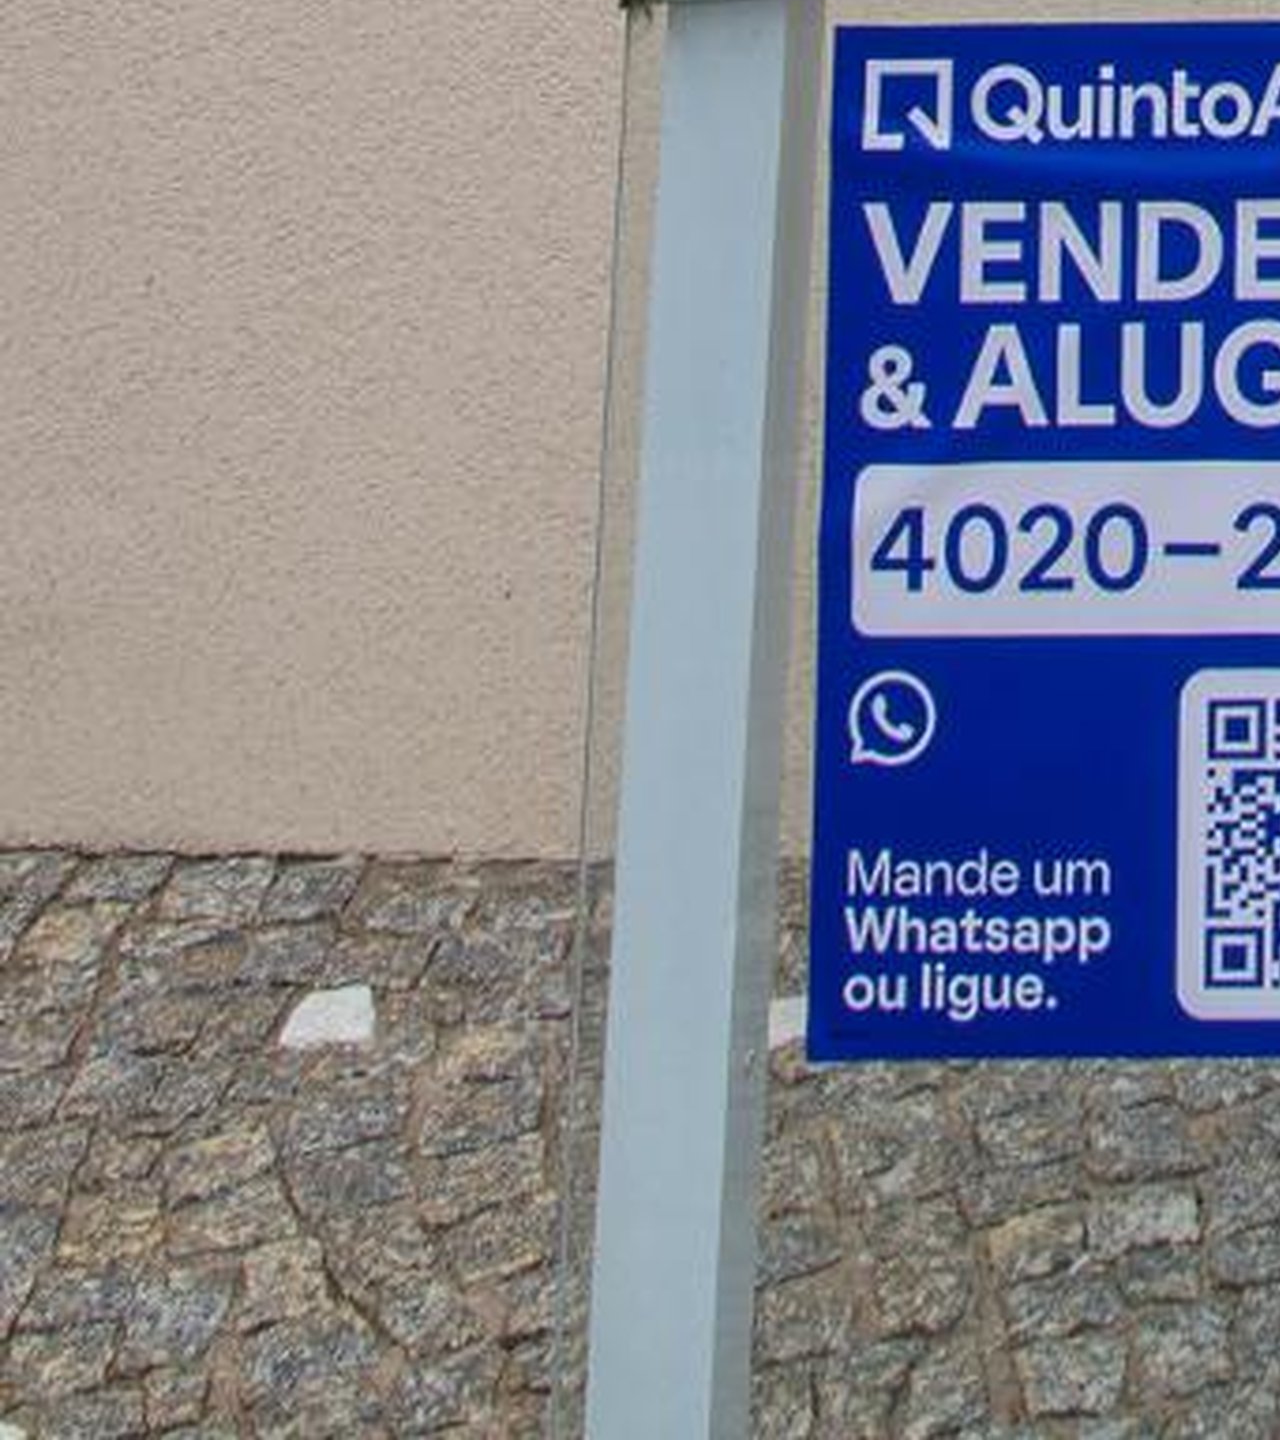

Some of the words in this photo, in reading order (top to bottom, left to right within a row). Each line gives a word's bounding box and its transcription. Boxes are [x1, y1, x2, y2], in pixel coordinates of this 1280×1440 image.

[861, 345, 931, 429] &
[848, 849, 1020, 896] Mande
[1034, 860, 1110, 895] um
[845, 906, 1110, 963] Whatsapp
[844, 974, 907, 1009] ou
[921, 964, 1057, 1021] ligue.
